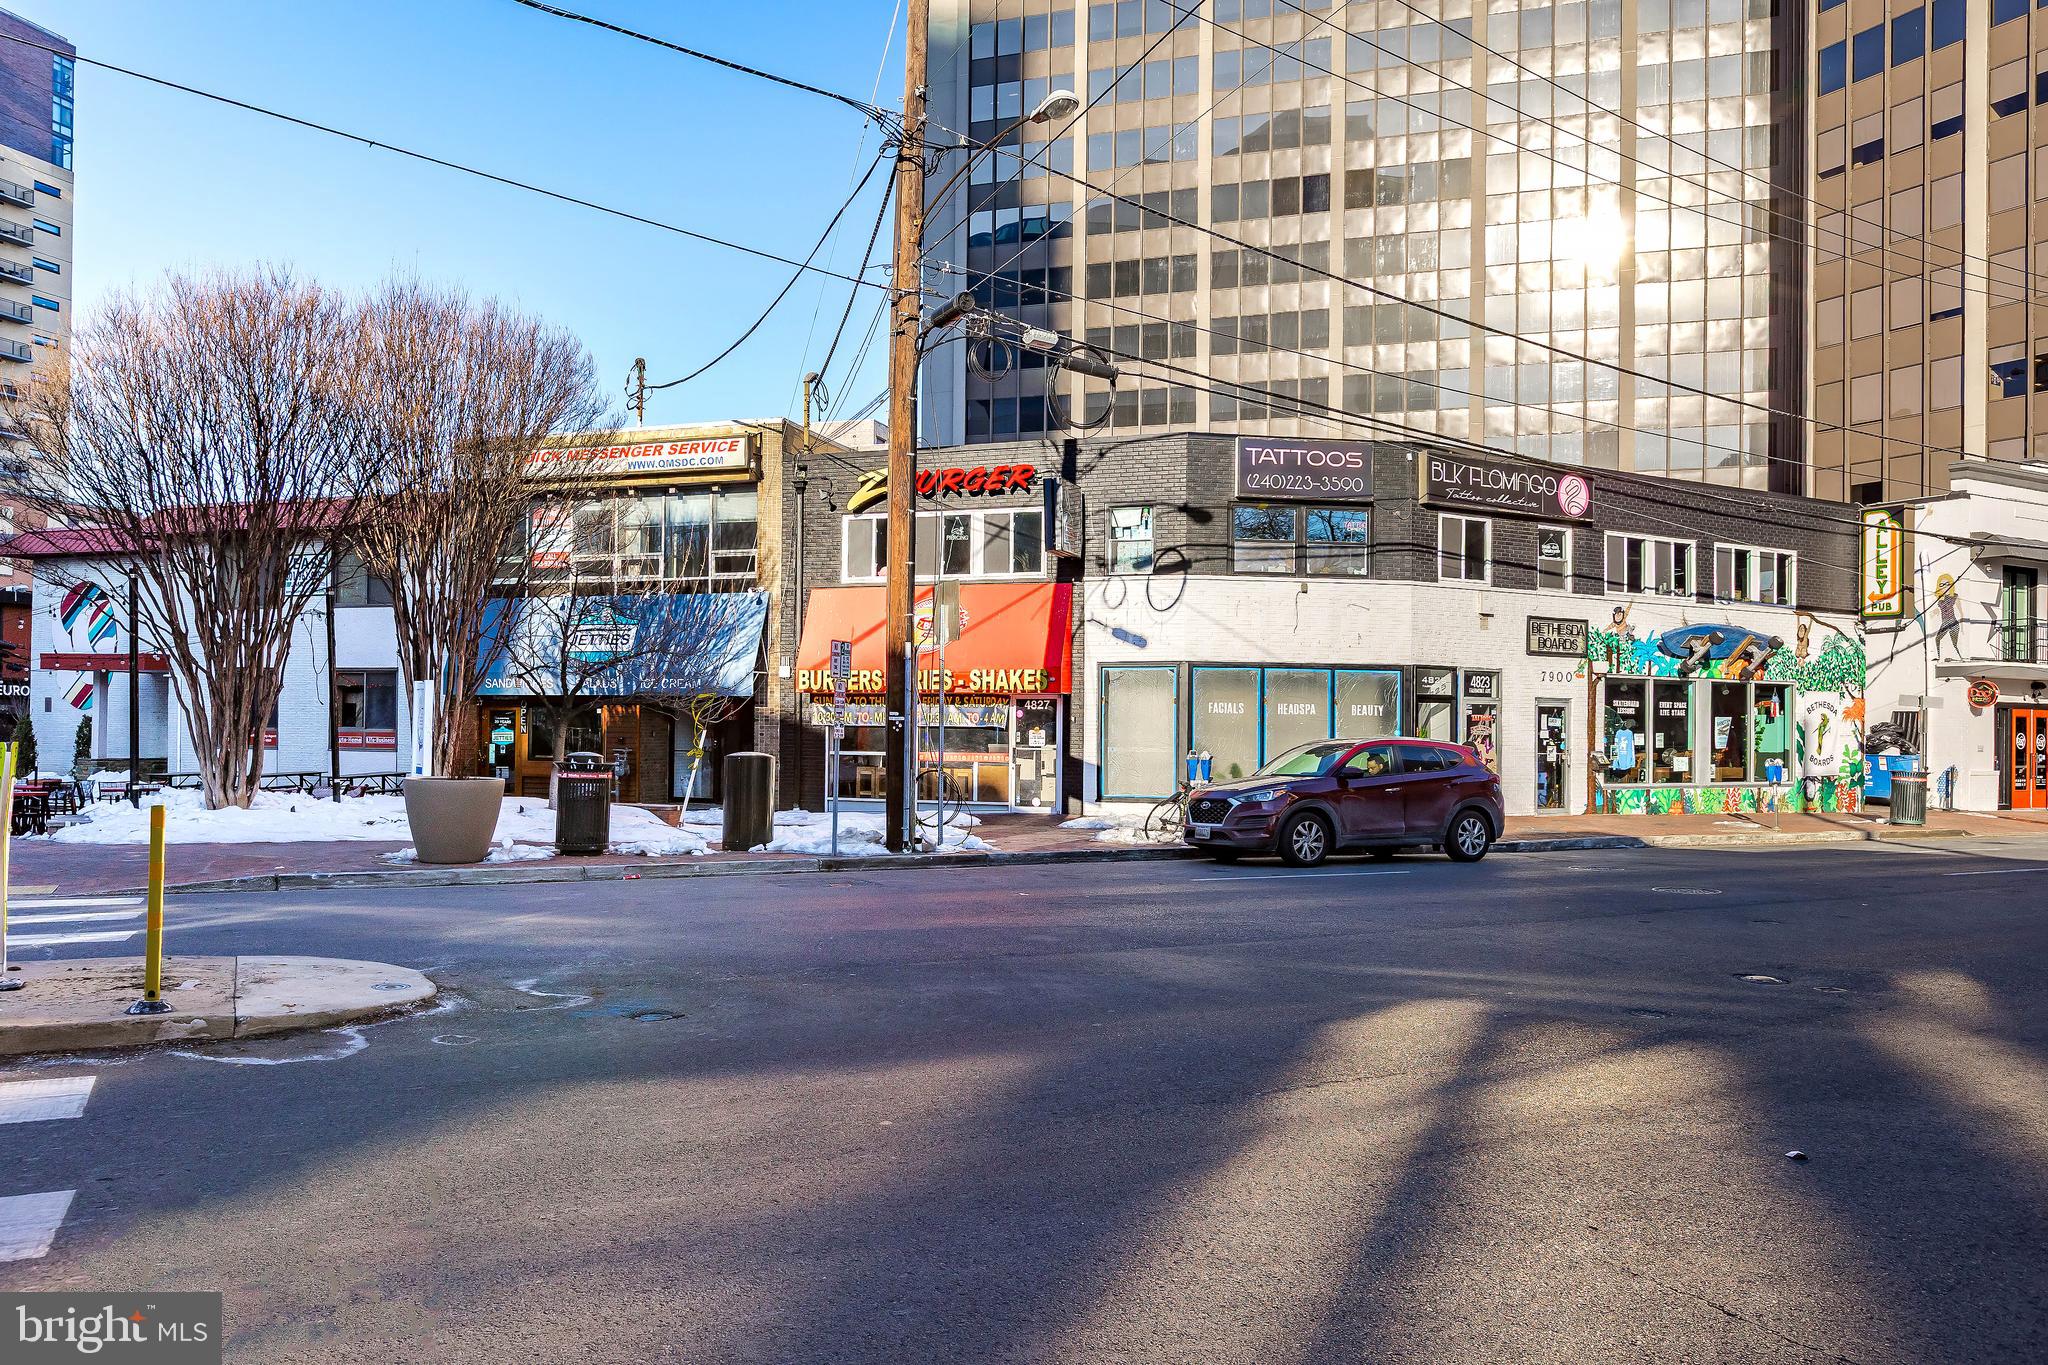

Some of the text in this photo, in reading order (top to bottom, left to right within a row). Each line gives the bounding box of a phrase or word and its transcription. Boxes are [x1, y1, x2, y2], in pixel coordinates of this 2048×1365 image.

[566, 443, 664, 463] MESSENGER
[667, 439, 740, 456] SERVICE
[1245, 447, 1363, 468] TATTOOS
[627, 456, 724, 470] WWW.QMSDC.COM
[915, 463, 1036, 495] URGER
[1431, 460, 1467, 484] BLK
[1247, 473, 1364, 492] (240)223-3590
[1876, 518, 1888, 595] ALLEY
[1871, 602, 1893, 612] PUB
[1531, 621, 1585, 637] BETHESDA
[1537, 636, 1579, 651] BOARDS
[798, 668, 884, 691] BURERS
[969, 668, 1048, 691] SHAKES
[1421, 676, 1442, 684] 482
[1470, 675, 1491, 688] 4823
[1541, 671, 1573, 682] 7900
[813, 696, 852, 708] SUNY
[1024, 700, 1051, 710] 4827
[1208, 702, 1245, 714] FACIALS
[1277, 703, 1317, 715] HEADSPA
[1806, 700, 1838, 717] BETHESDA
[1351, 704, 1384, 717] BEAUTY
[1809, 754, 1834, 767] BOARDS
